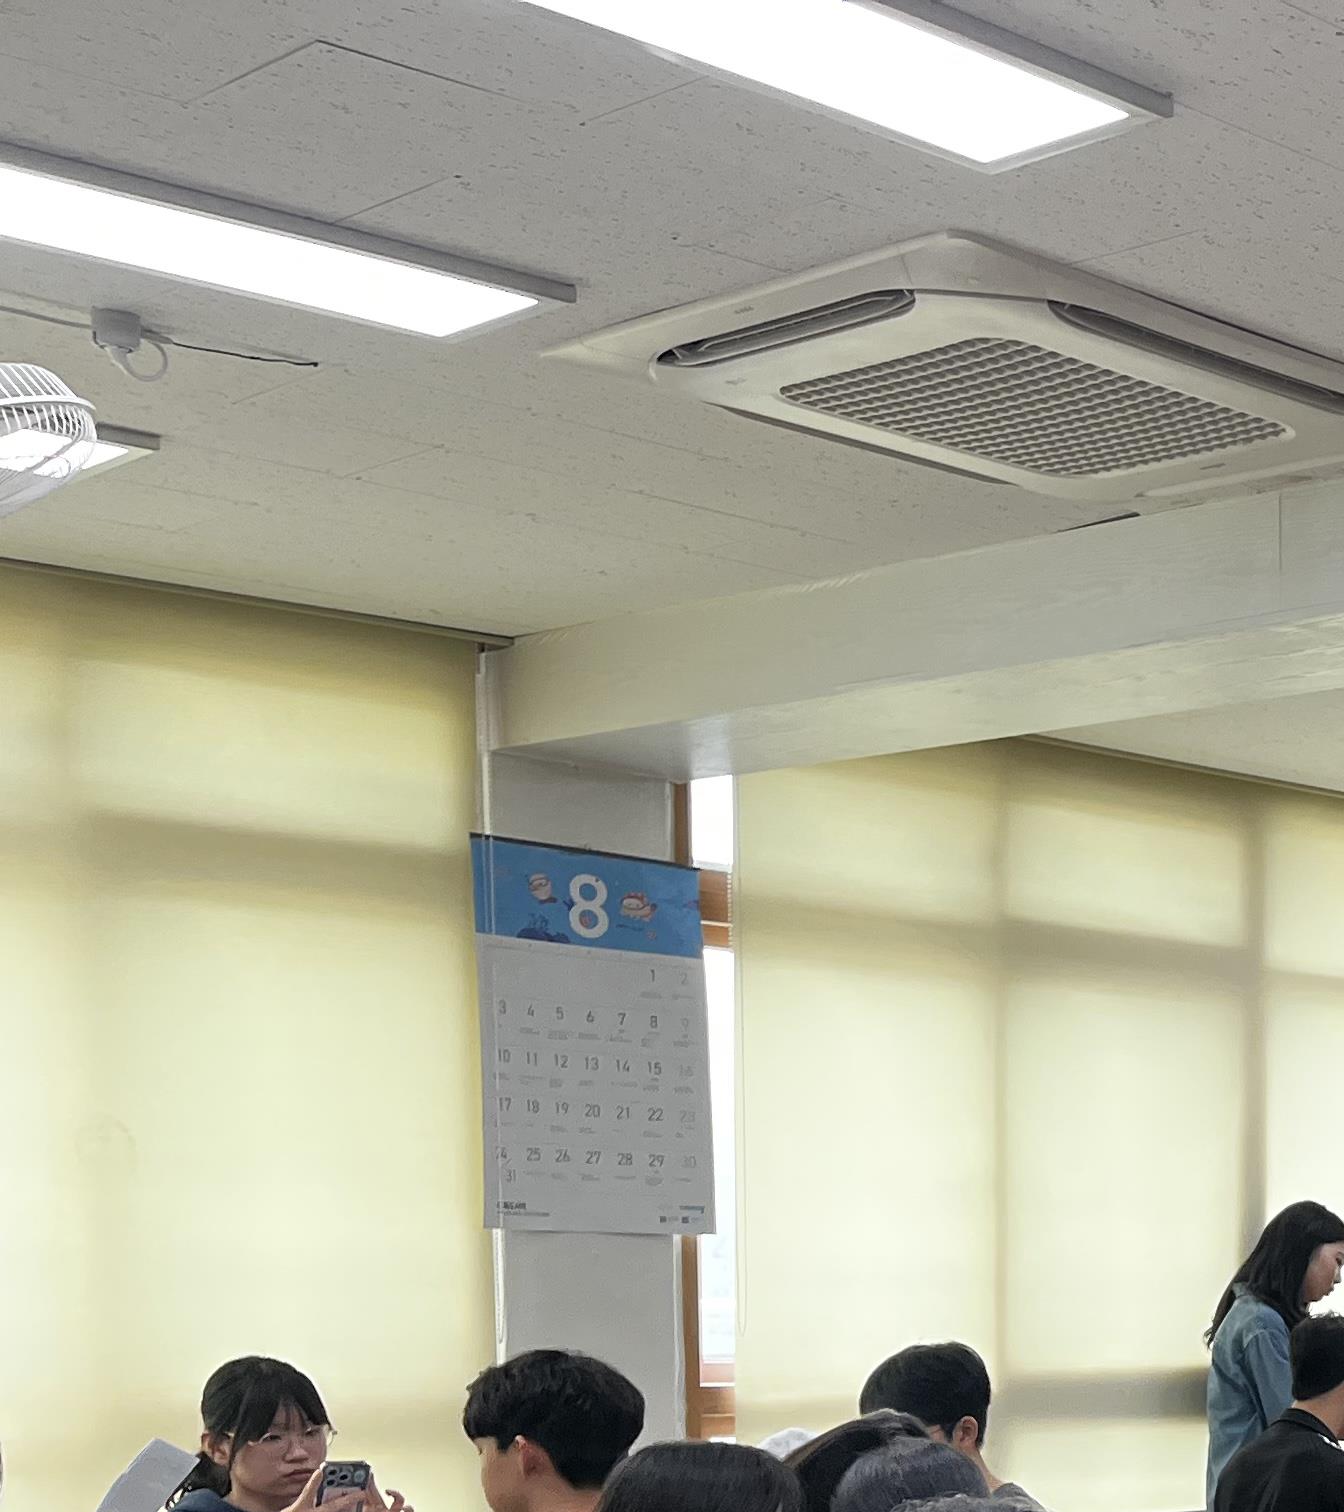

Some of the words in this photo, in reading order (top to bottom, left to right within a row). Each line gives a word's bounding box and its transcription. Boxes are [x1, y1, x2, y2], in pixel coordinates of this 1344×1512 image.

[568, 873, 609, 939] 8
[526, 1003, 536, 1017] 4
[555, 1005, 565, 1021] 5
[585, 1009, 596, 1024] 6
[616, 1011, 627, 1026] 7
[649, 1014, 659, 1029] 8
[525, 1051, 539, 1066] 11
[553, 1053, 569, 1069] 12
[583, 1056, 600, 1071] 13
[615, 1058, 631, 1073] 14
[647, 1060, 663, 1076] 15
[498, 1097, 512, 1112] 17
[525, 1099, 541, 1114] 18
[554, 1101, 570, 1115] 19
[584, 1103, 600, 1119] 20
[616, 1105, 631, 1121] 21
[646, 1107, 665, 1122] 22
[525, 1147, 542, 1163] 25
[554, 1149, 571, 1164] 26
[584, 1150, 602, 1165] 27
[616, 1152, 633, 1167] 28
[648, 1154, 666, 1168] 29
